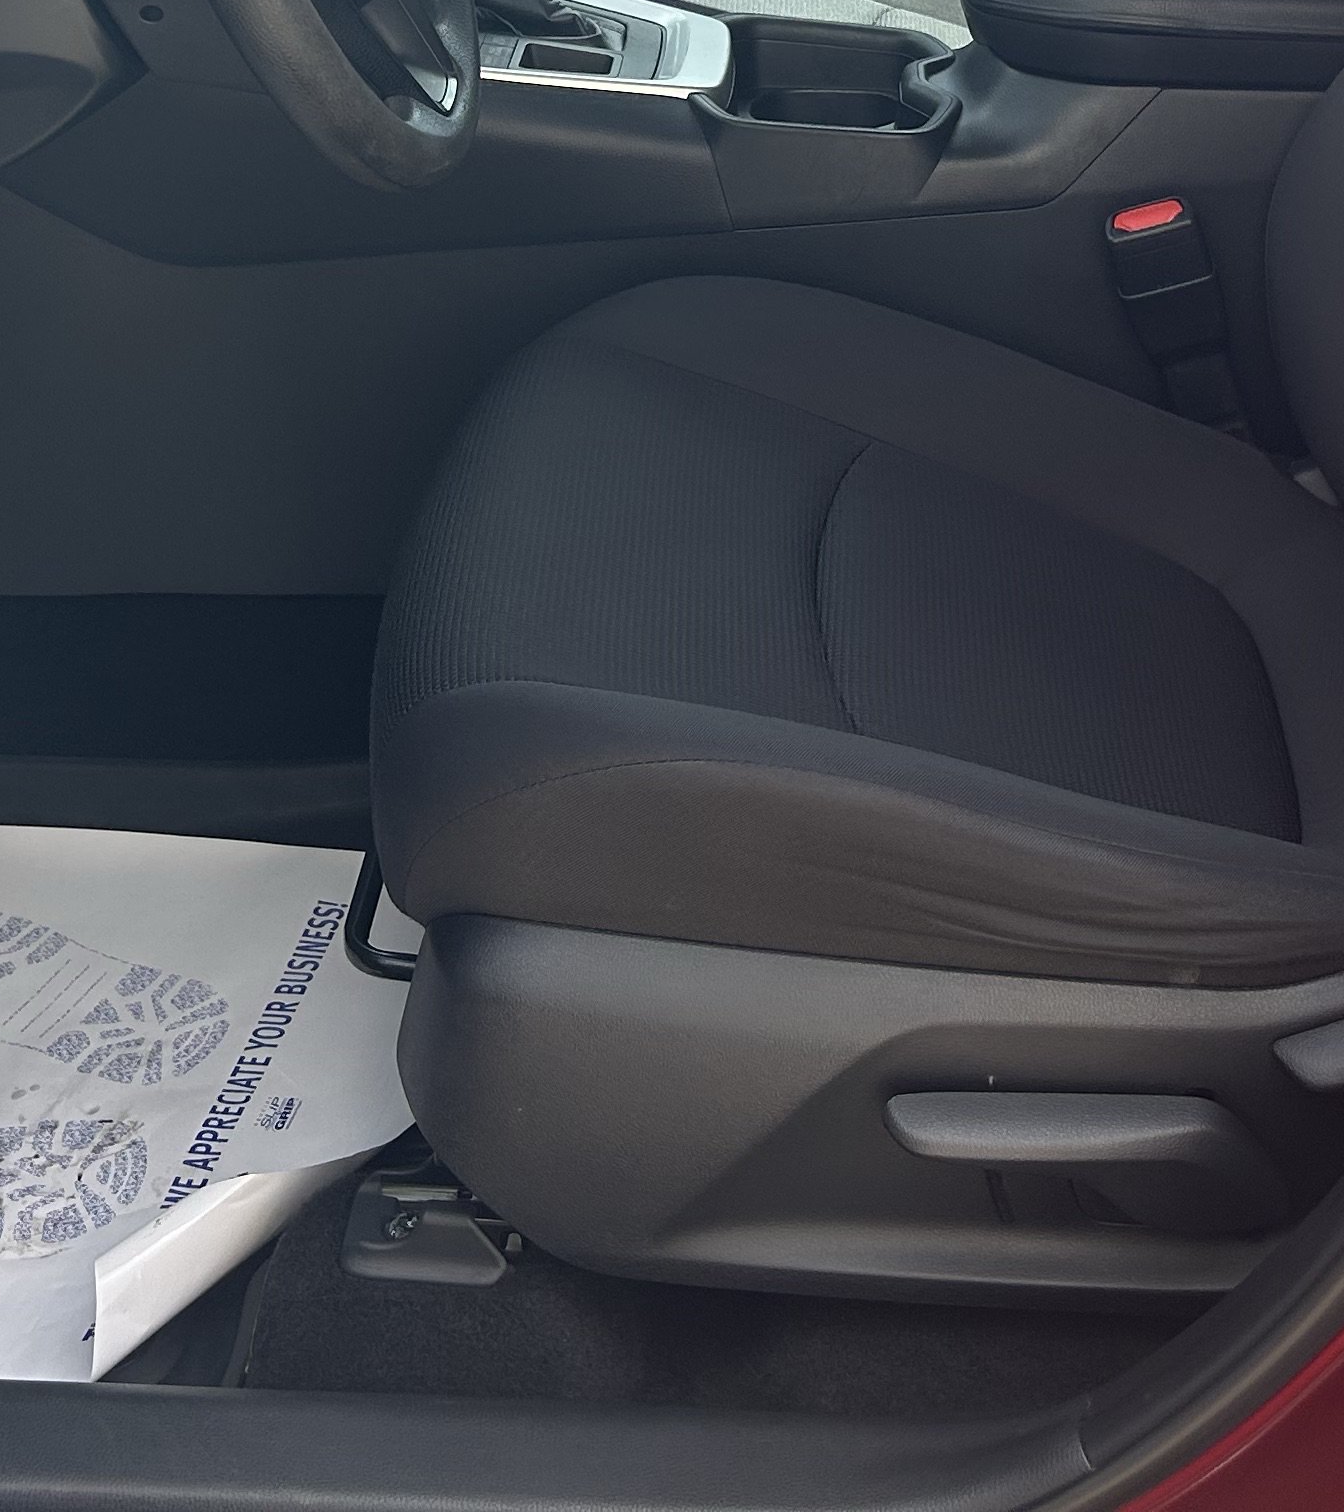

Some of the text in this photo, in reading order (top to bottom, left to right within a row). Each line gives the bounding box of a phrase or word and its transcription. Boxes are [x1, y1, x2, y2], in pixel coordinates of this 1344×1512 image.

[160, 899, 349, 1209] WE APPRECIATE YOUR BUSINESS!
[261, 1096, 279, 1129] SLIP
[275, 1097, 295, 1130] GRIP
